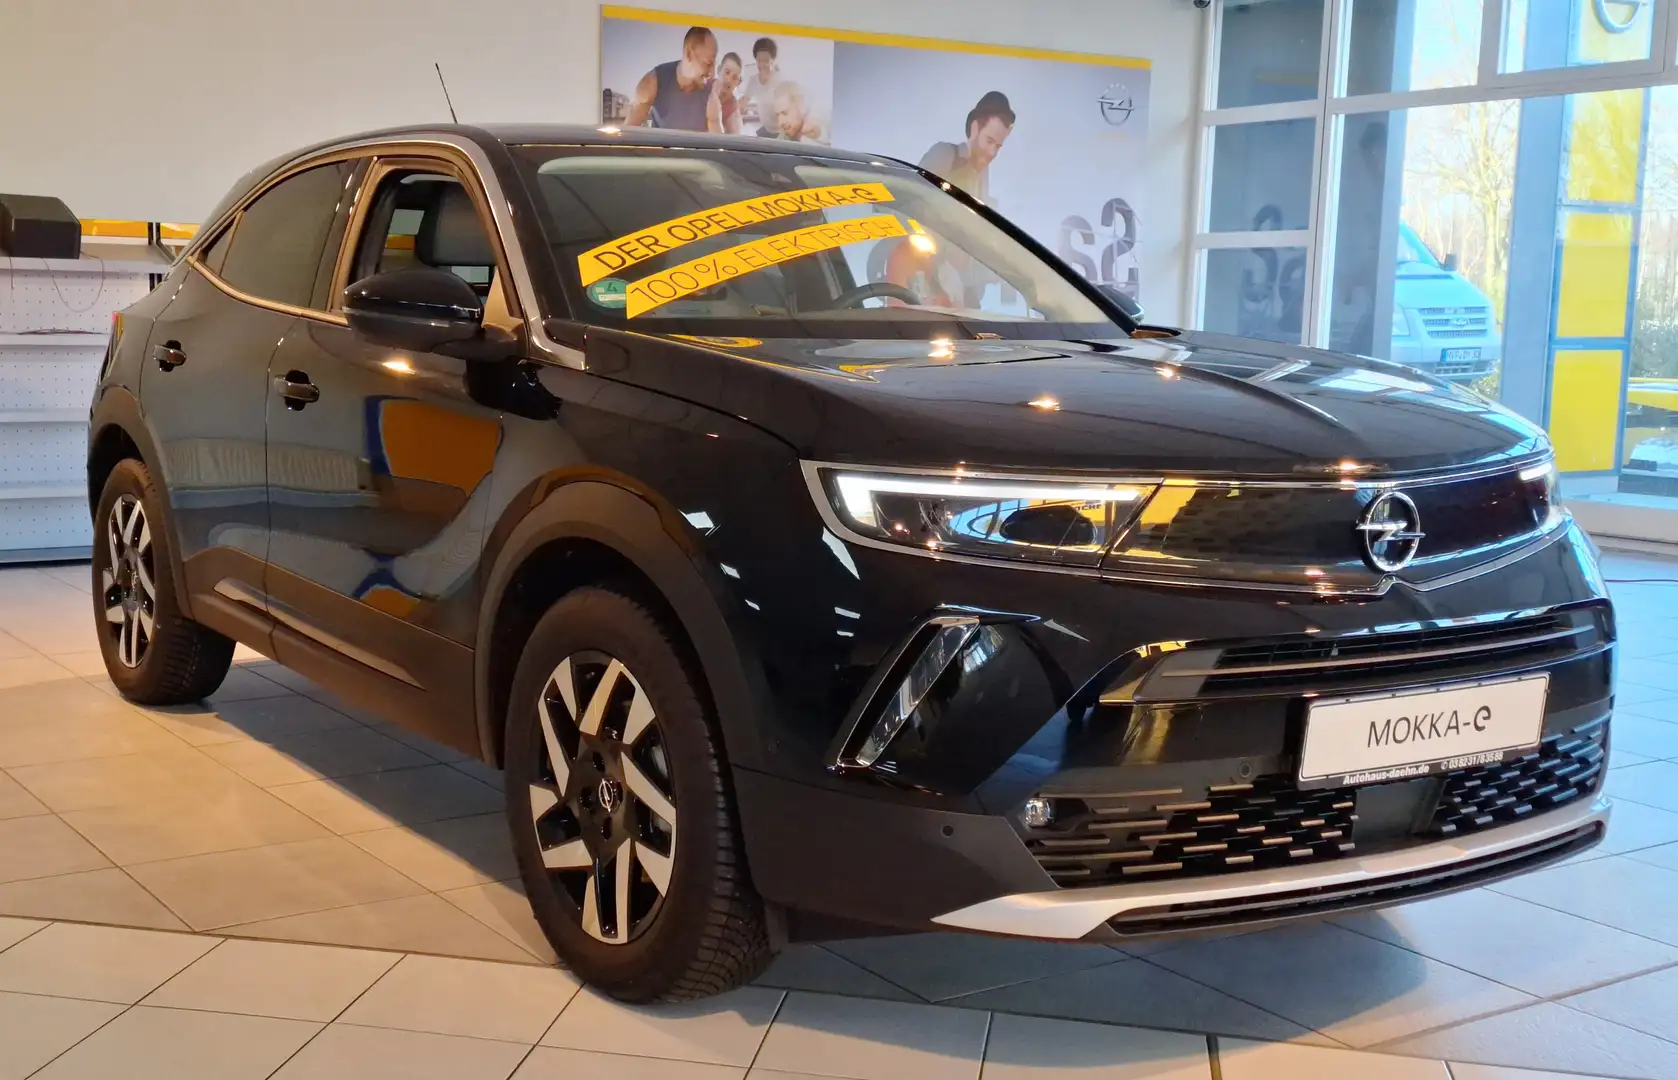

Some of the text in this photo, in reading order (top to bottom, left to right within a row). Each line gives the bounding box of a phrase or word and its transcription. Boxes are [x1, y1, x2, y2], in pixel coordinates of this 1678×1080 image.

[593, 235, 670, 271] DER
[667, 211, 753, 241] OPEL
[734, 221, 893, 268] ELEKTRISCH
[1343, 765, 1430, 785] Autohaus-daehn.de
